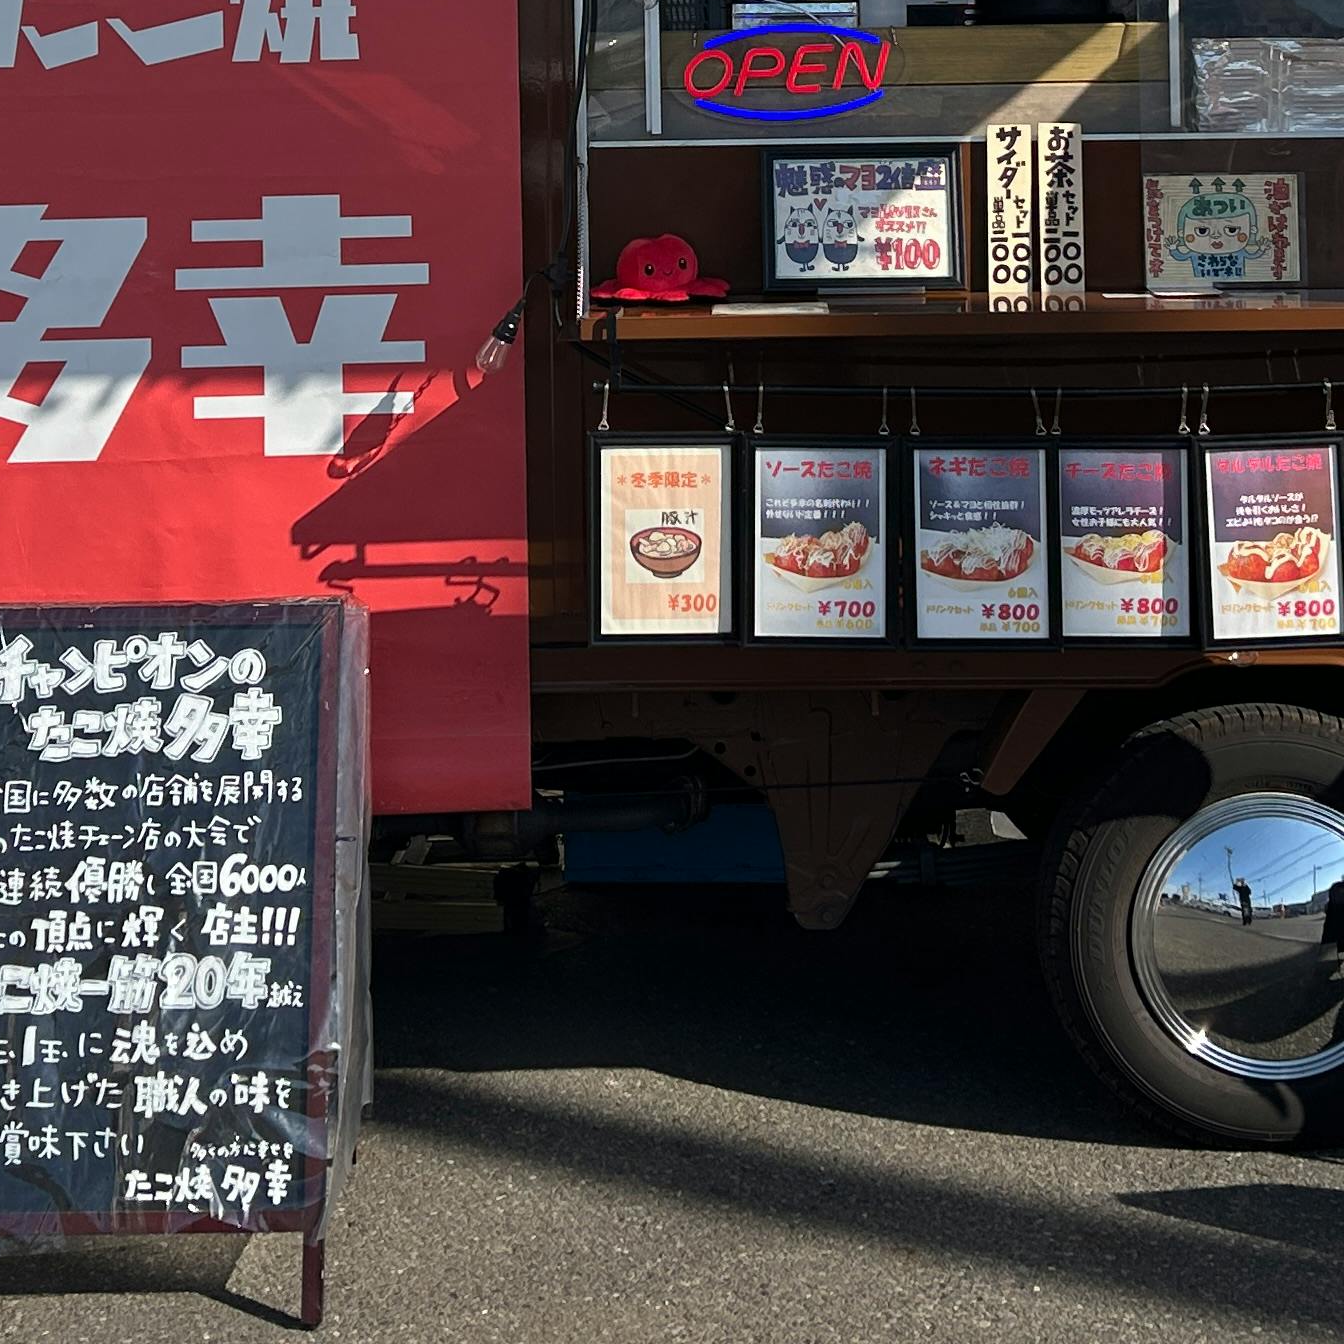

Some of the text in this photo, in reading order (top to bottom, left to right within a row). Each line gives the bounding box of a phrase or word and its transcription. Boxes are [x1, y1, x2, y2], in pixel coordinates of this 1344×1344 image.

[683, 40, 890, 99] OPEN
[995, 126, 1027, 199] サイダー
[1044, 126, 1076, 188] お茶
[1192, 195, 1246, 217] あつい
[874, 236, 940, 271] ¥100
[766, 460, 873, 479] ソースたこ焼
[1216, 454, 1323, 473] タルタルたこ焼
[661, 509, 699, 526] 豚汁
[668, 593, 717, 614] ¥300
[818, 600, 876, 617] ¥700
[981, 603, 1040, 620] ¥800
[1120, 598, 1178, 614] ¥800
[1277, 599, 1335, 617] ¥800
[1001, 622, 1040, 633] ¥700
[27, 688, 283, 763] たこ焼多幸
[165, 853, 307, 899] 全国6000人
[190, 1134, 295, 1160] 多くの方に幸せを
